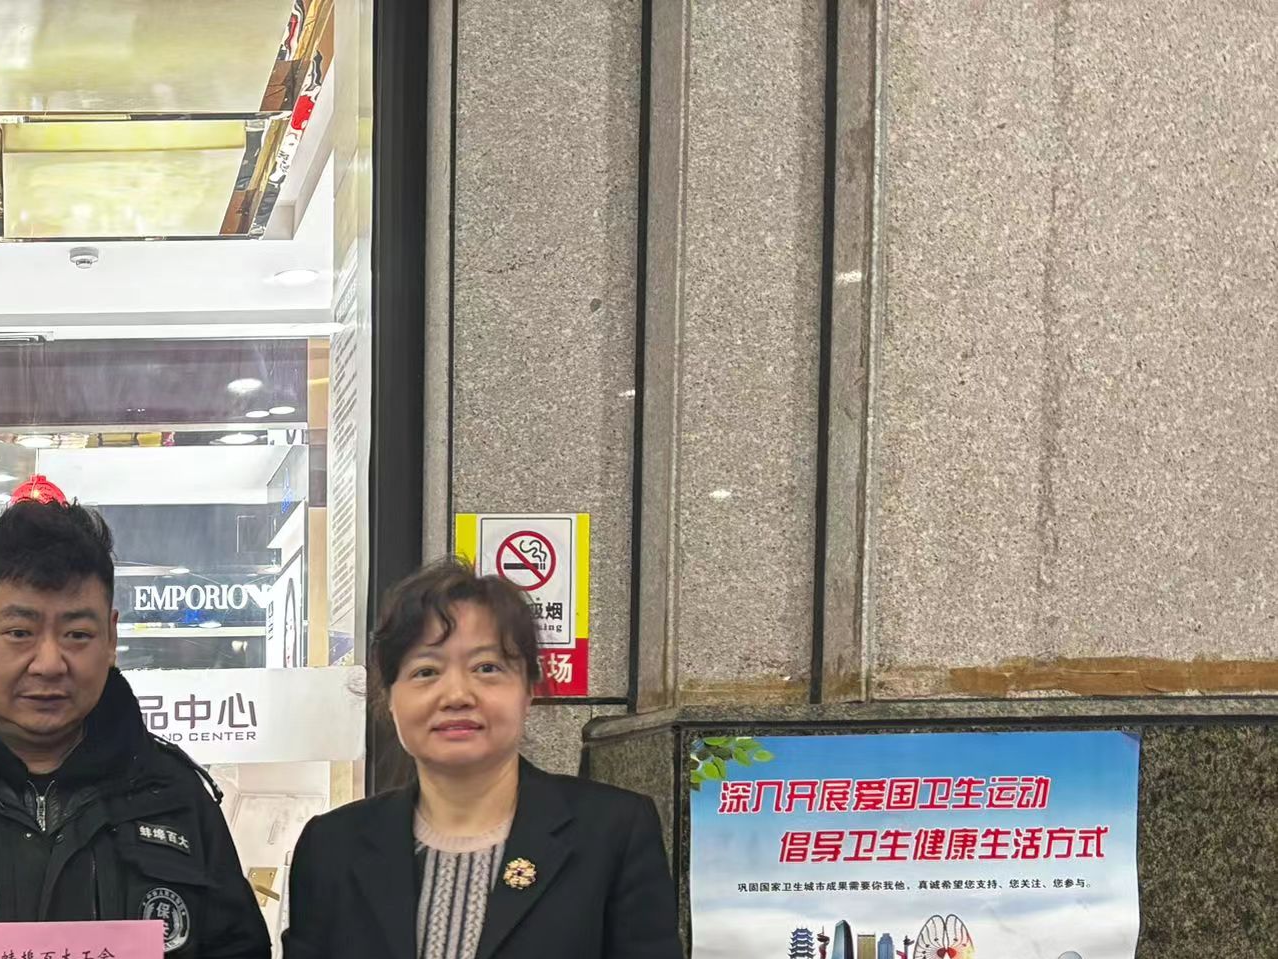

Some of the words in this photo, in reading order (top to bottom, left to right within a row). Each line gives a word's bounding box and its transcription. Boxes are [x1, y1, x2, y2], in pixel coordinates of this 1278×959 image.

[133, 584, 248, 611] EMPORIO
[188, 731, 257, 742] CENTER
[718, 777, 1051, 814] 深入开展爱国卫生运动
[139, 825, 190, 849] 蚌埠百大
[779, 826, 1110, 863] 倡导卫生健康生活方式
